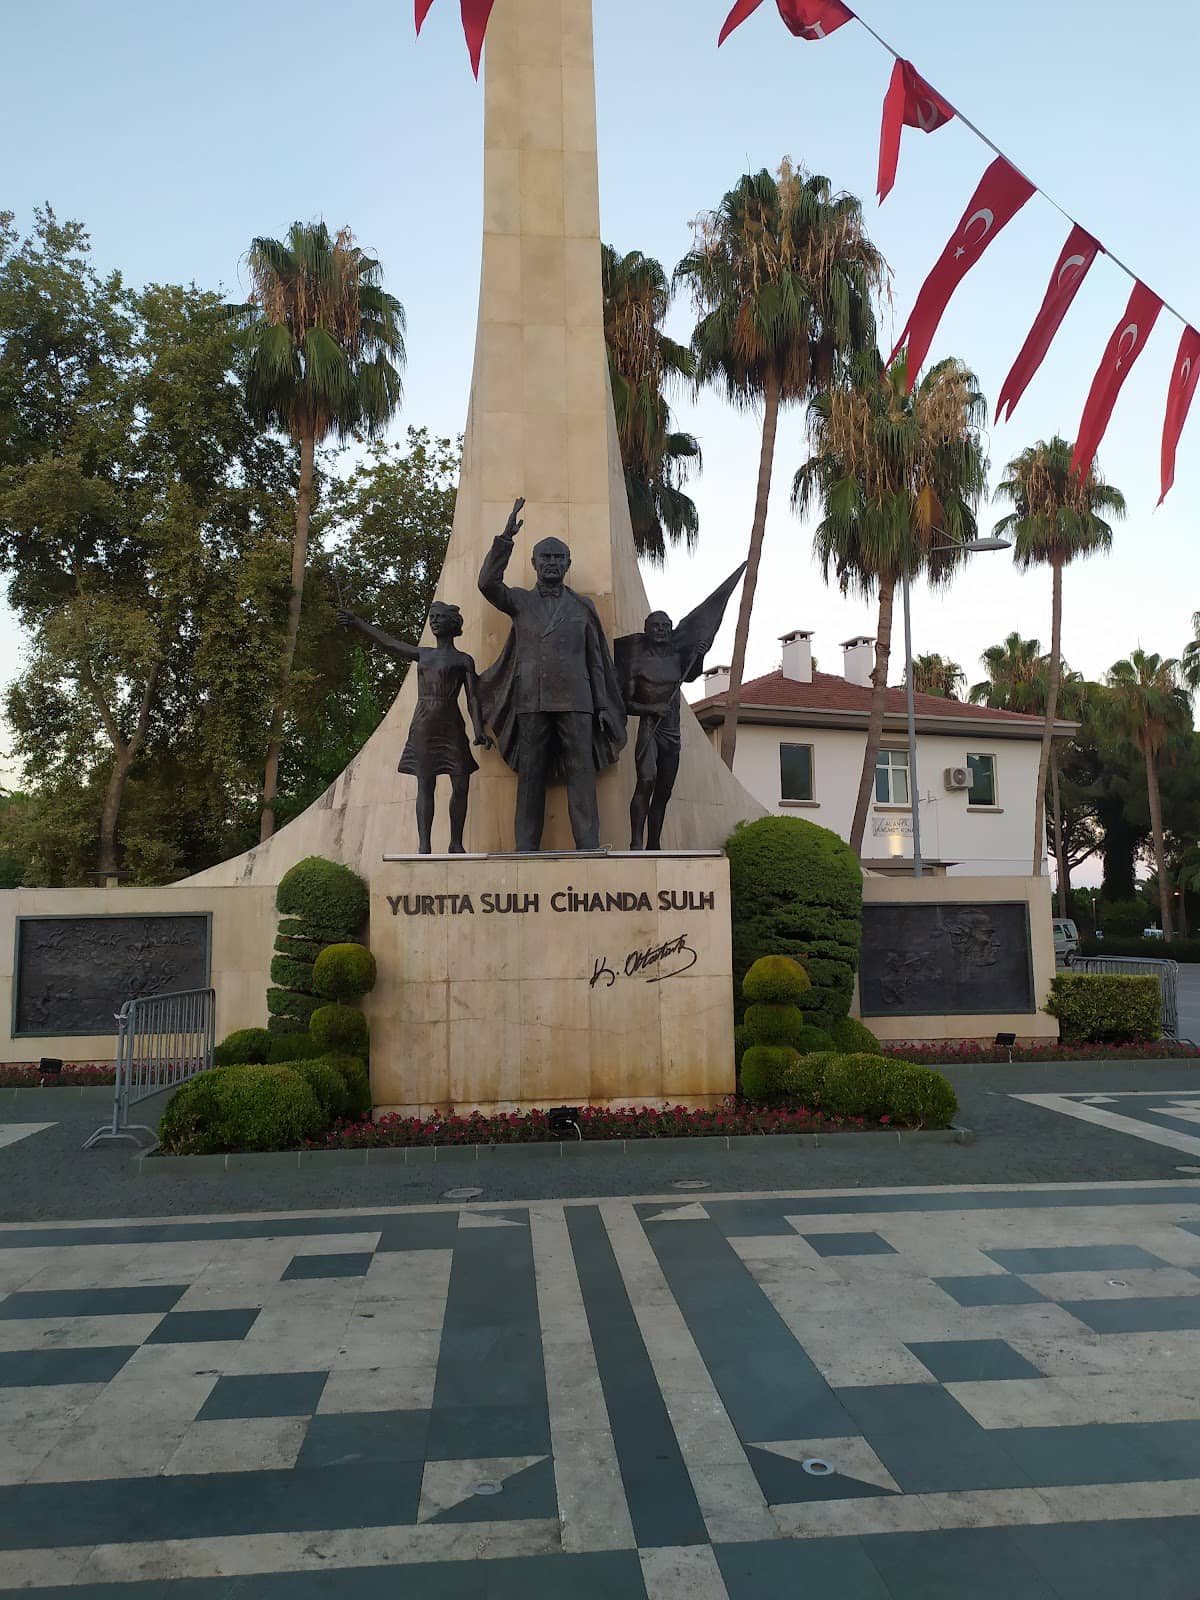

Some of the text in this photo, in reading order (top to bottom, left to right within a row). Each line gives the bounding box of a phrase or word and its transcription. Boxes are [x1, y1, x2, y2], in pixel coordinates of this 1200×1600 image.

[386, 886, 714, 915] YURTTA SULH CİHANDA SULH
